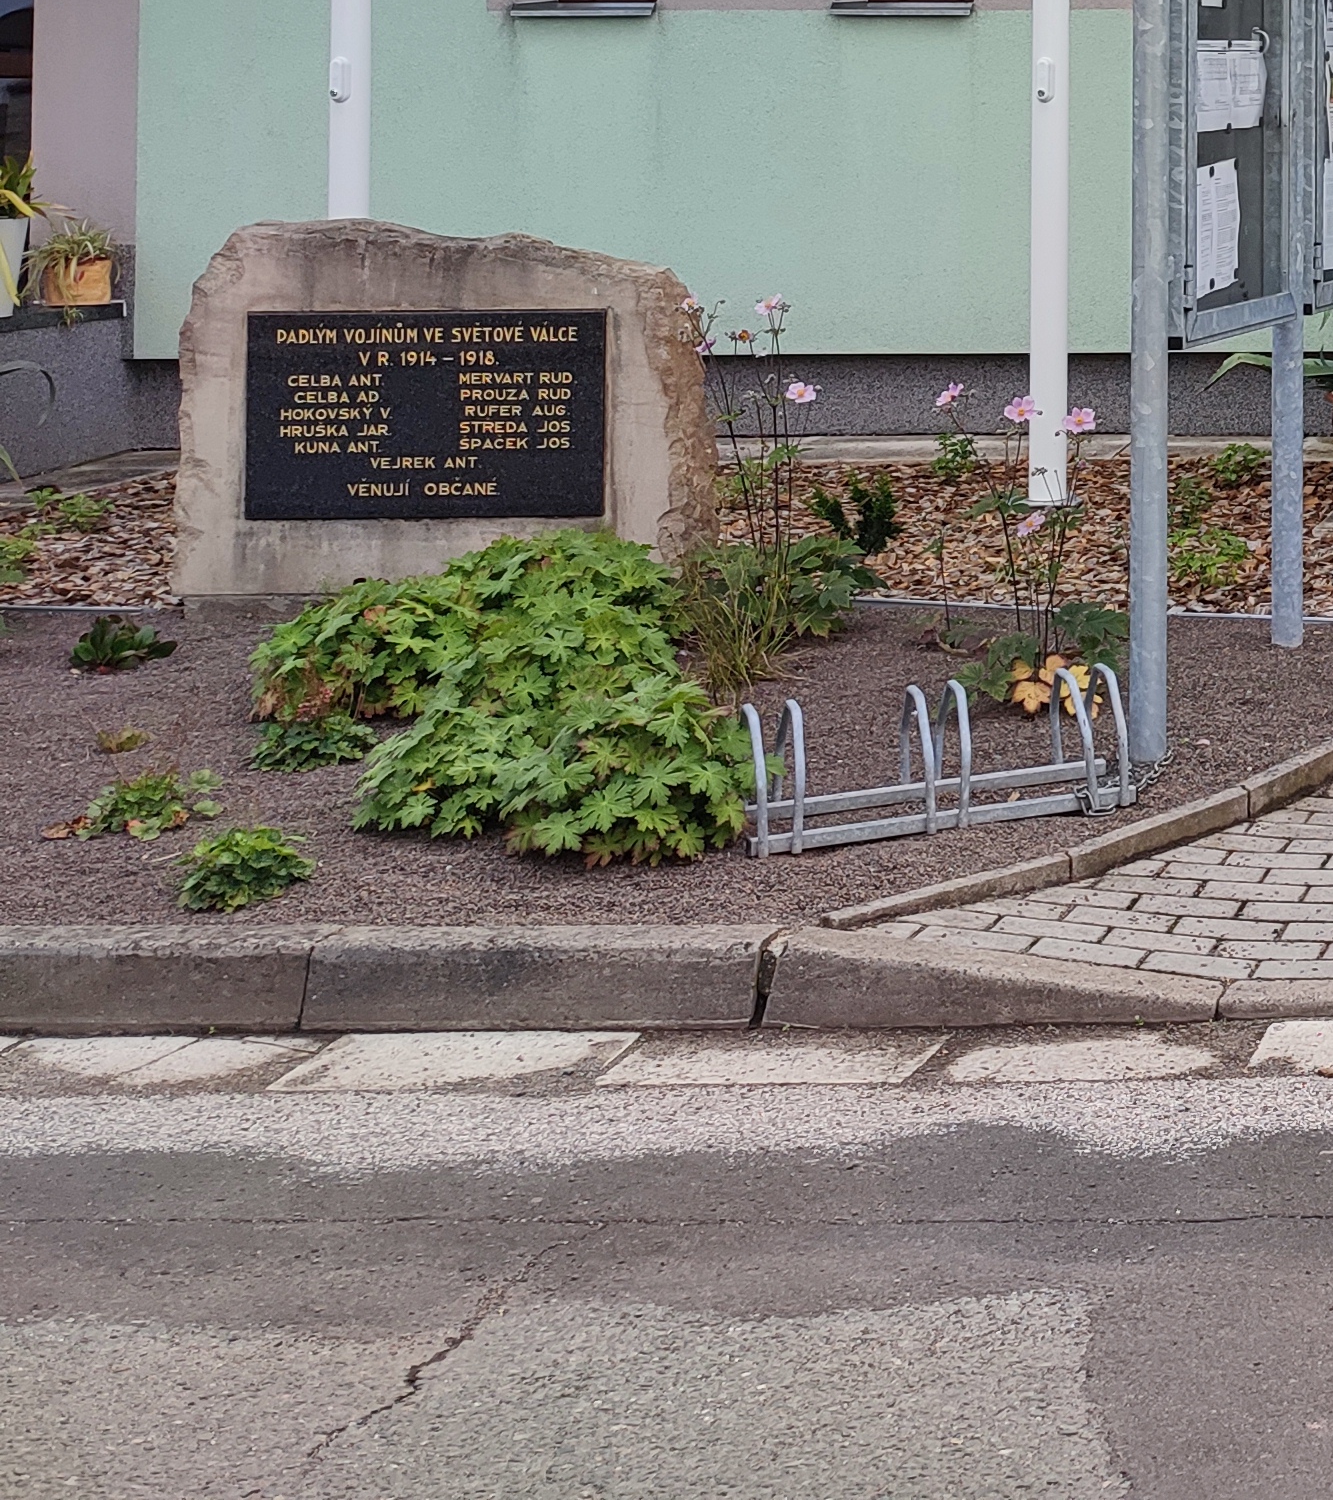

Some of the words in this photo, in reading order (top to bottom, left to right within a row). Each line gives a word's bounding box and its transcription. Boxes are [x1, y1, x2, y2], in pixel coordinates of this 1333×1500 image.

[276, 322, 337, 344] PADLÝM
[343, 322, 418, 344] VOJÍNŮM
[423, 327, 444, 343] VE
[451, 321, 524, 343] SVĚTOVÉ
[530, 320, 578, 342] VÁLCE
[358, 351, 371, 366] V
[377, 351, 394, 367] R.
[400, 350, 437, 367] 1914
[459, 350, 500, 366] 1918.
[287, 374, 342, 387] CELBA
[348, 373, 385, 387] ANT.
[459, 372, 534, 385] MERVART
[539, 371, 578, 384] RUD.
[293, 391, 350, 403] CELBA
[460, 388, 530, 401] PROUZA
[280, 404, 373, 420] HOKOVSKÝ
[464, 405, 523, 417] RUFER
[531, 404, 571, 416] AUG.
[279, 422, 349, 438] HRUŠKA
[459, 417, 528, 434] STŘEDA
[294, 441, 341, 454] KUNA
[370, 456, 436, 469] VEJREK
[443, 456, 482, 469] ANT.
[347, 477, 410, 497] VĚNUJÍ
